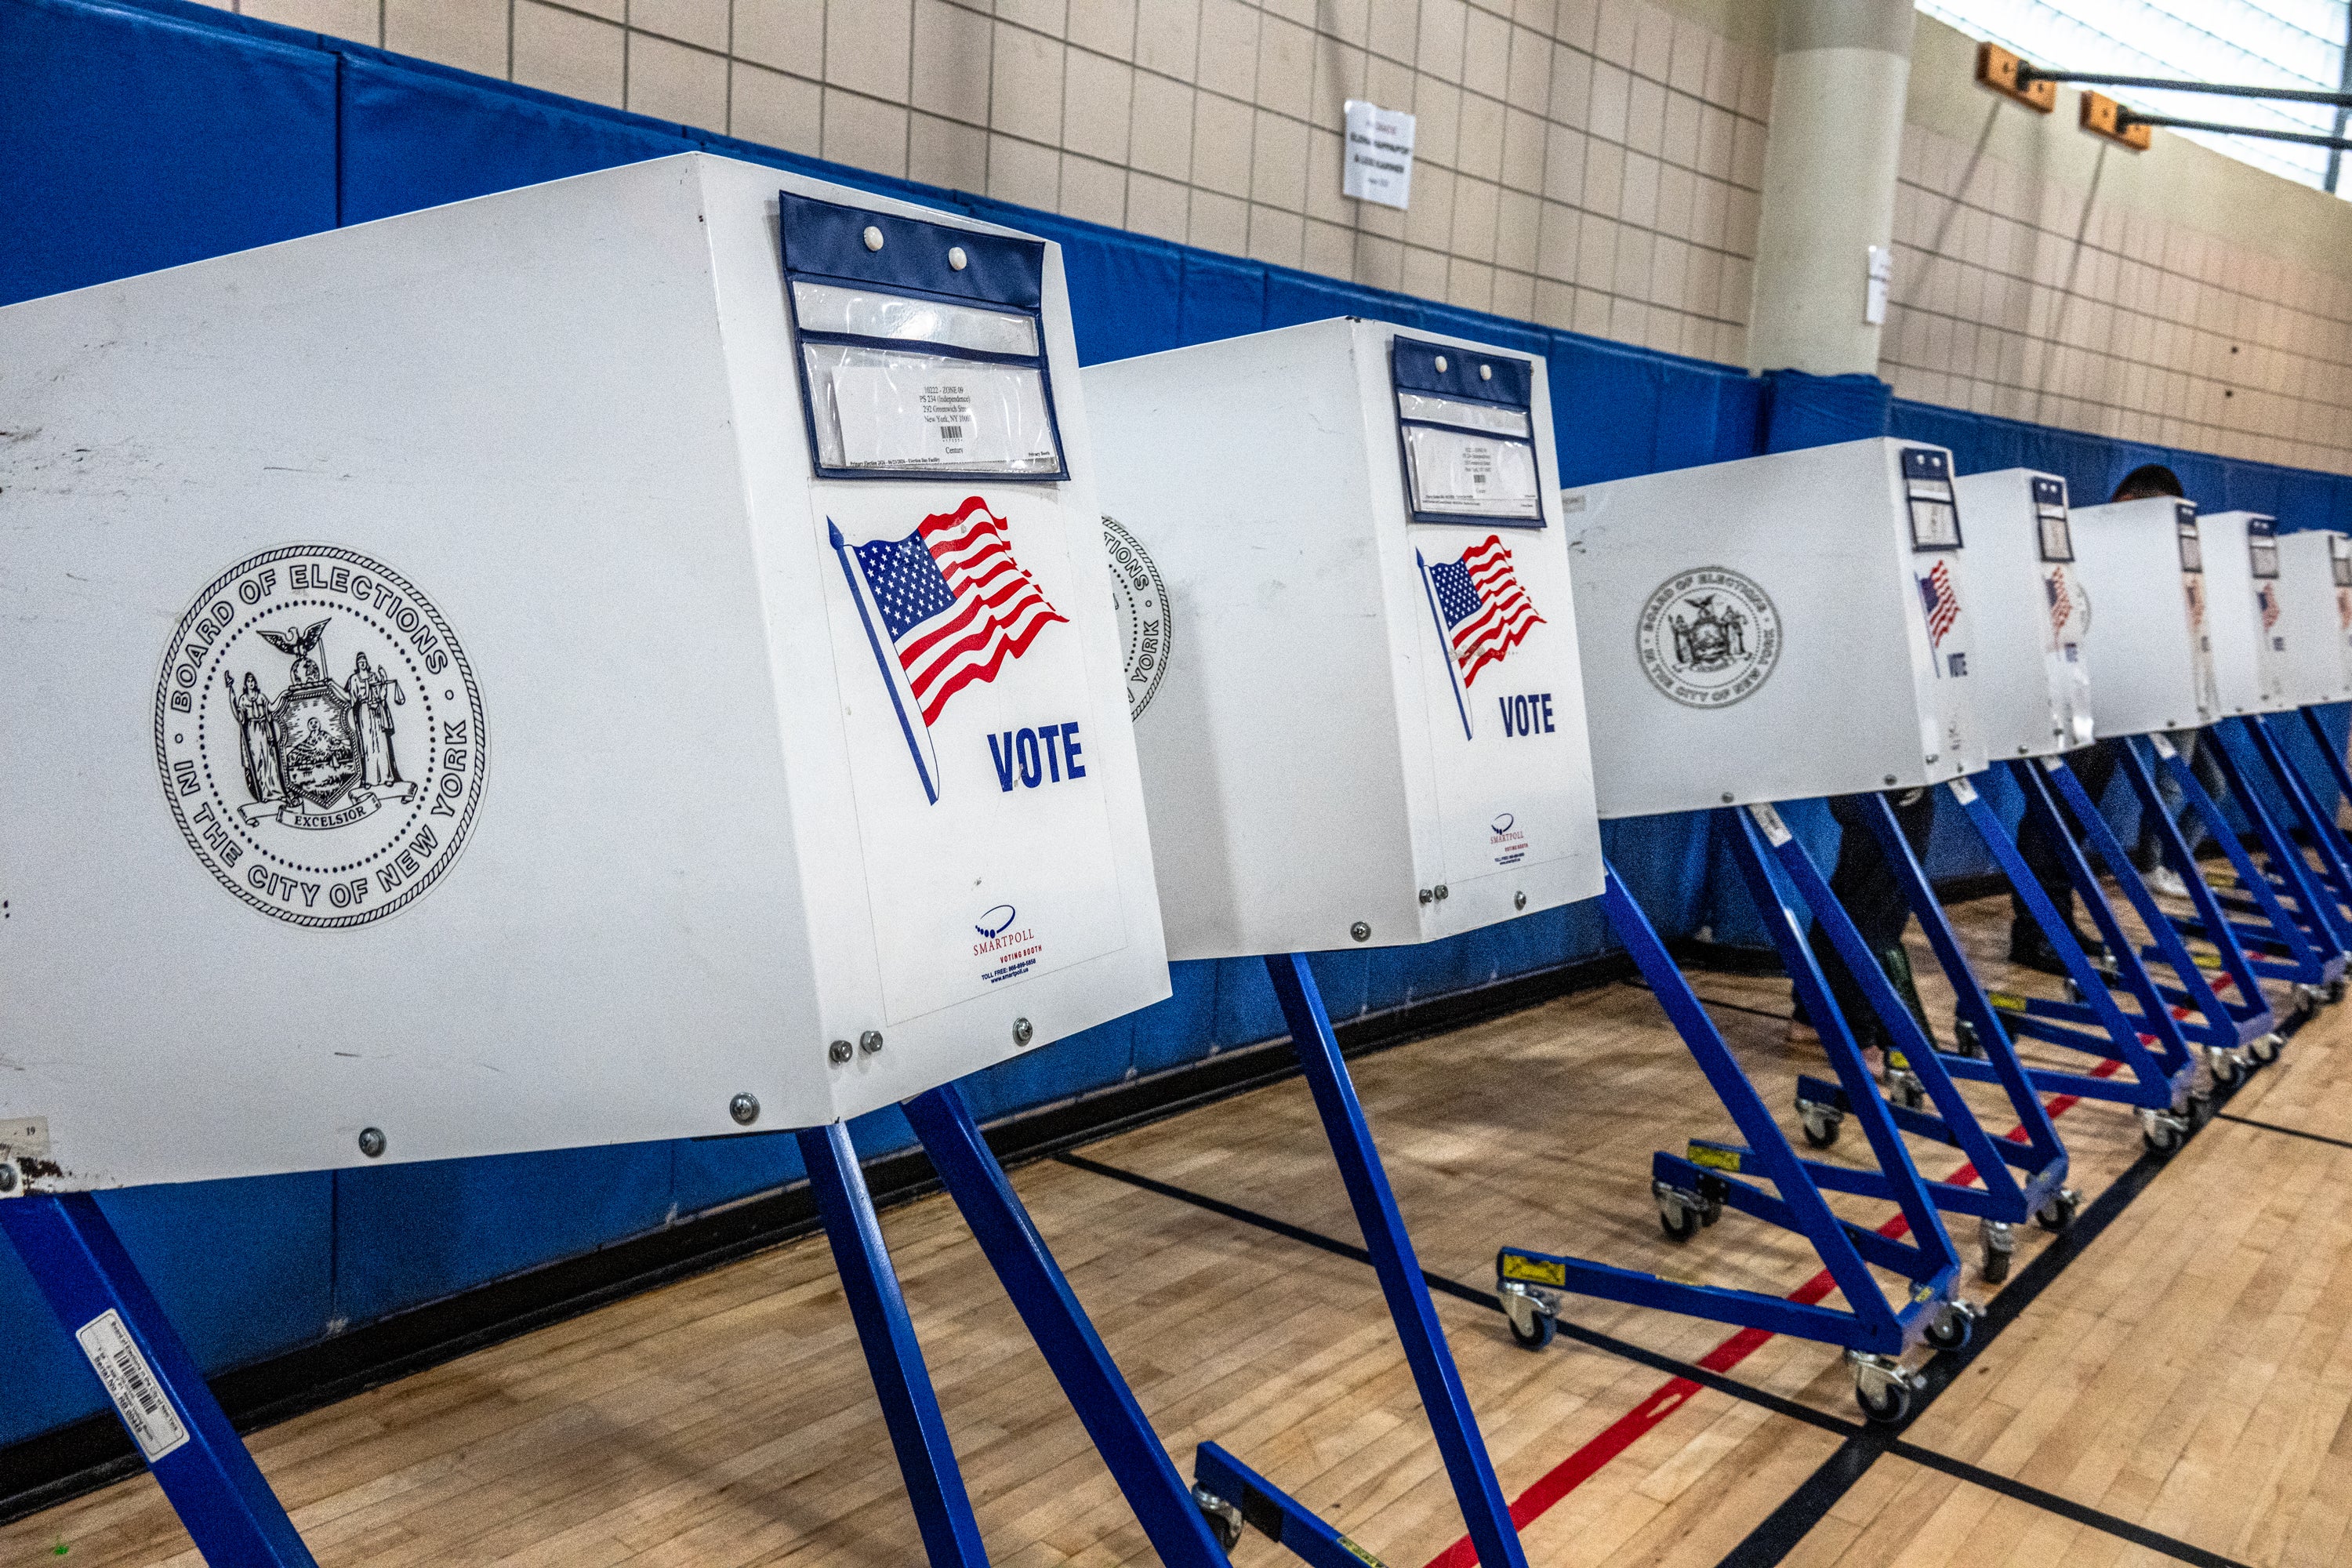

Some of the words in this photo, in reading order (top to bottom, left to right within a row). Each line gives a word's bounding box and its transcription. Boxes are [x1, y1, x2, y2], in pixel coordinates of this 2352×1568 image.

[171, 600, 235, 713] BOARD
[238, 568, 277, 604] OF
[289, 564, 448, 674] ELECTIONS
[1131, 619, 1159, 683] YORK
[1498, 693, 1555, 738] VOTE
[987, 721, 1087, 793] VOTE
[174, 760, 201, 797] IN
[193, 802, 243, 868] THE
[248, 864, 320, 906] CITY
[328, 878, 368, 908] OF
[376, 826, 439, 891] NEW
[430, 719, 467, 818] YORK
[294, 806, 367, 827] EXCELSIOR
[973, 928, 1035, 956] SMARTPOLL
[1000, 951, 1022, 964] VOTING
[1023, 945, 1042, 956] BOOTH
[982, 972, 993, 981] TOLL
[994, 967, 1007, 976] FREE:
[990, 967, 1029, 984] www.smartpoll.us
[27, 1127, 35, 1136] 19
